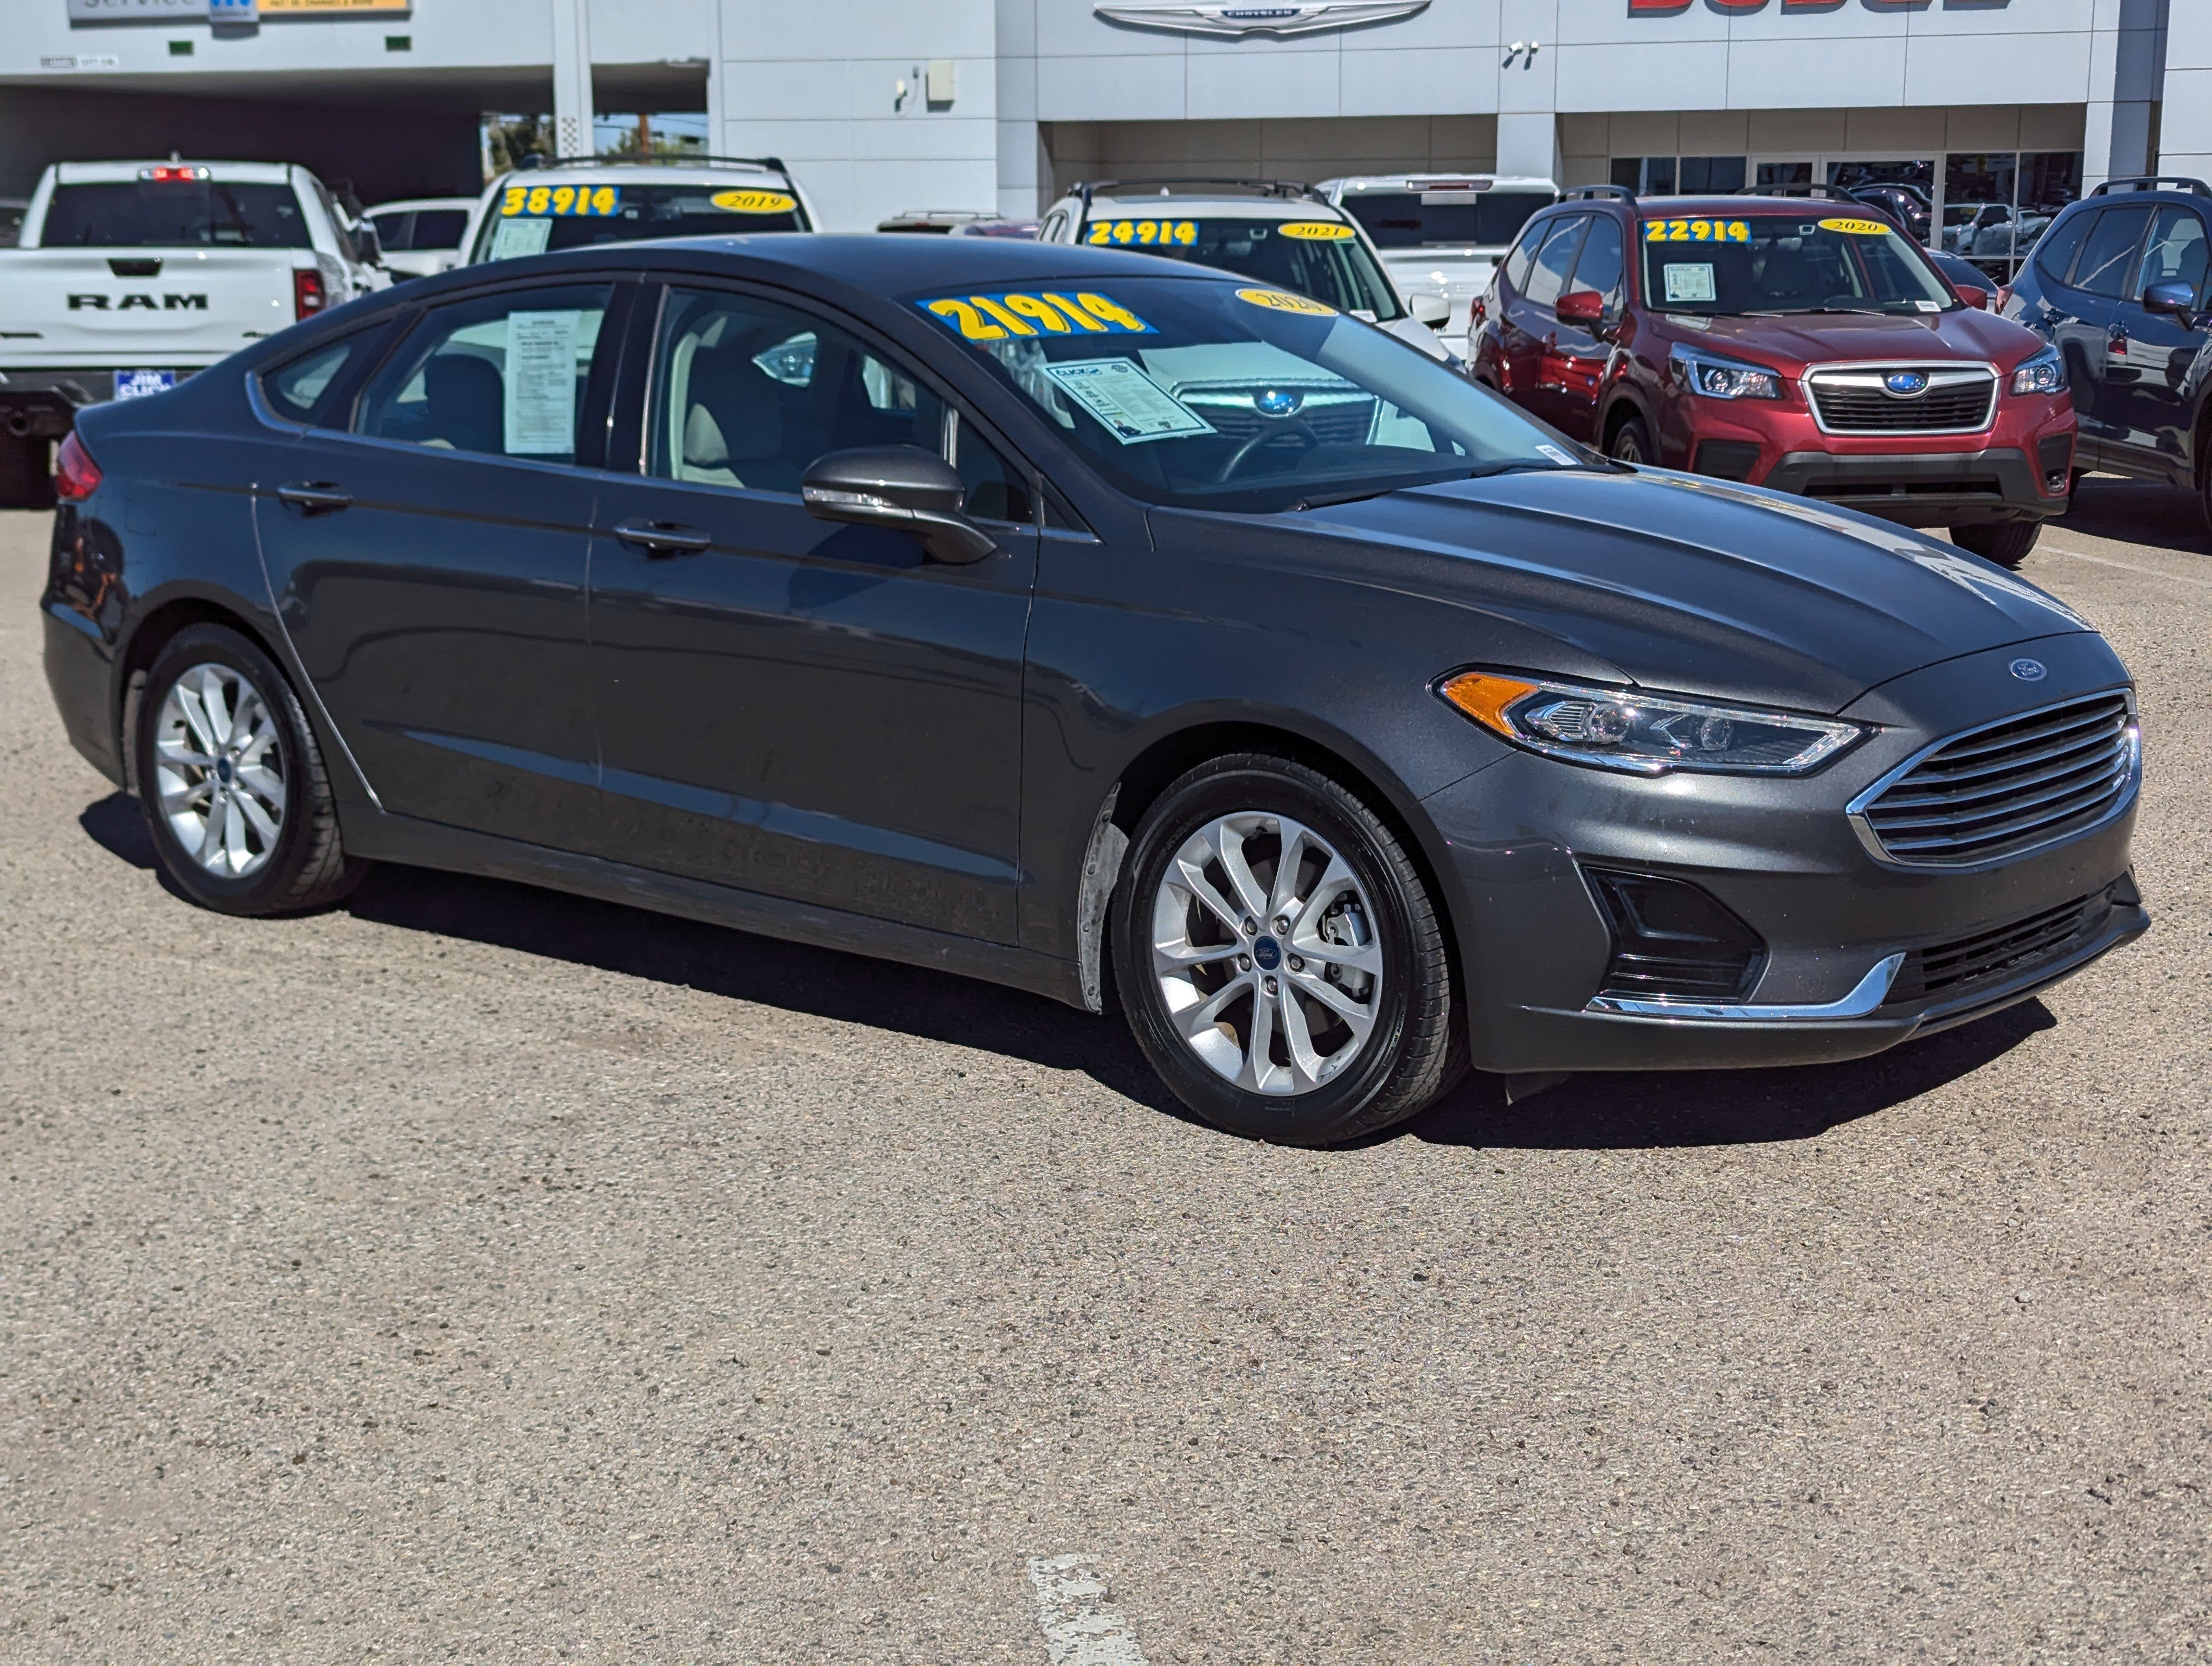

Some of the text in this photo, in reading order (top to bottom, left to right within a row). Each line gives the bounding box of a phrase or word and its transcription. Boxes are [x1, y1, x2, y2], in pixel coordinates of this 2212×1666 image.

[501, 187, 616, 215] 38914
[728, 195, 782, 208] 2019
[1088, 220, 1197, 245] 24914
[1295, 226, 1341, 236] 2021
[1645, 220, 1750, 242] 22914
[1834, 221, 1879, 232] 2020
[67, 294, 208, 311] RAM
[928, 292, 1146, 341] 21914
[131, 371, 162, 386] JIM
